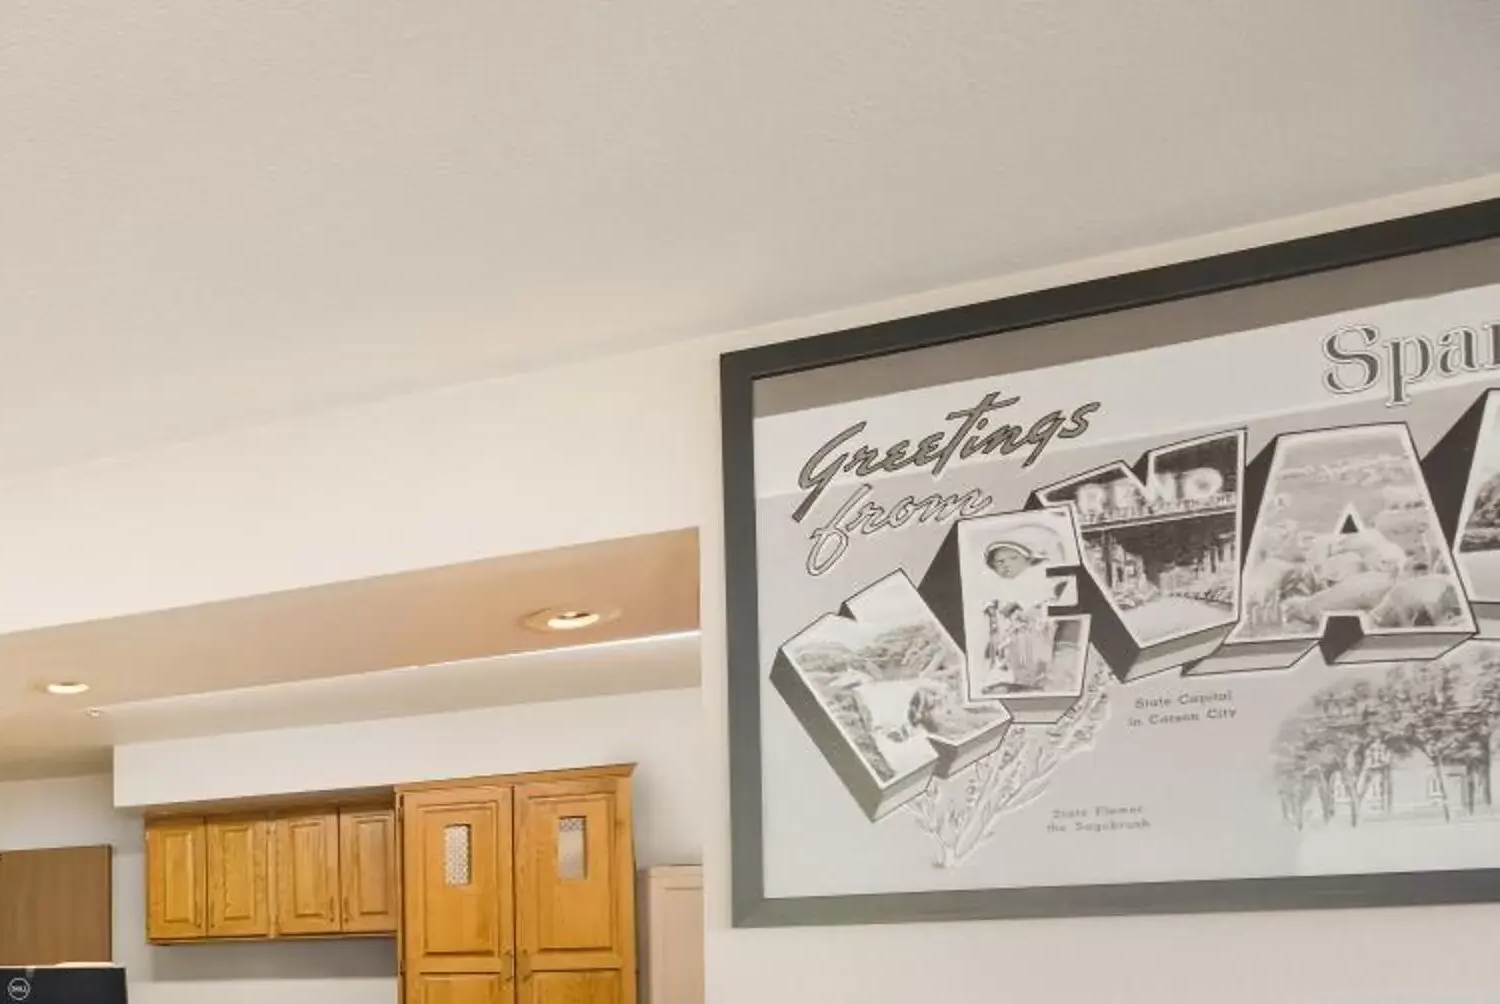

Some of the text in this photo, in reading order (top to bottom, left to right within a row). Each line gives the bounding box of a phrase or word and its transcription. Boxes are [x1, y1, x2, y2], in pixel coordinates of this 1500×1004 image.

[791, 391, 1102, 522] Greetings
[805, 483, 993, 577] from
[1134, 697, 1173, 710] State
